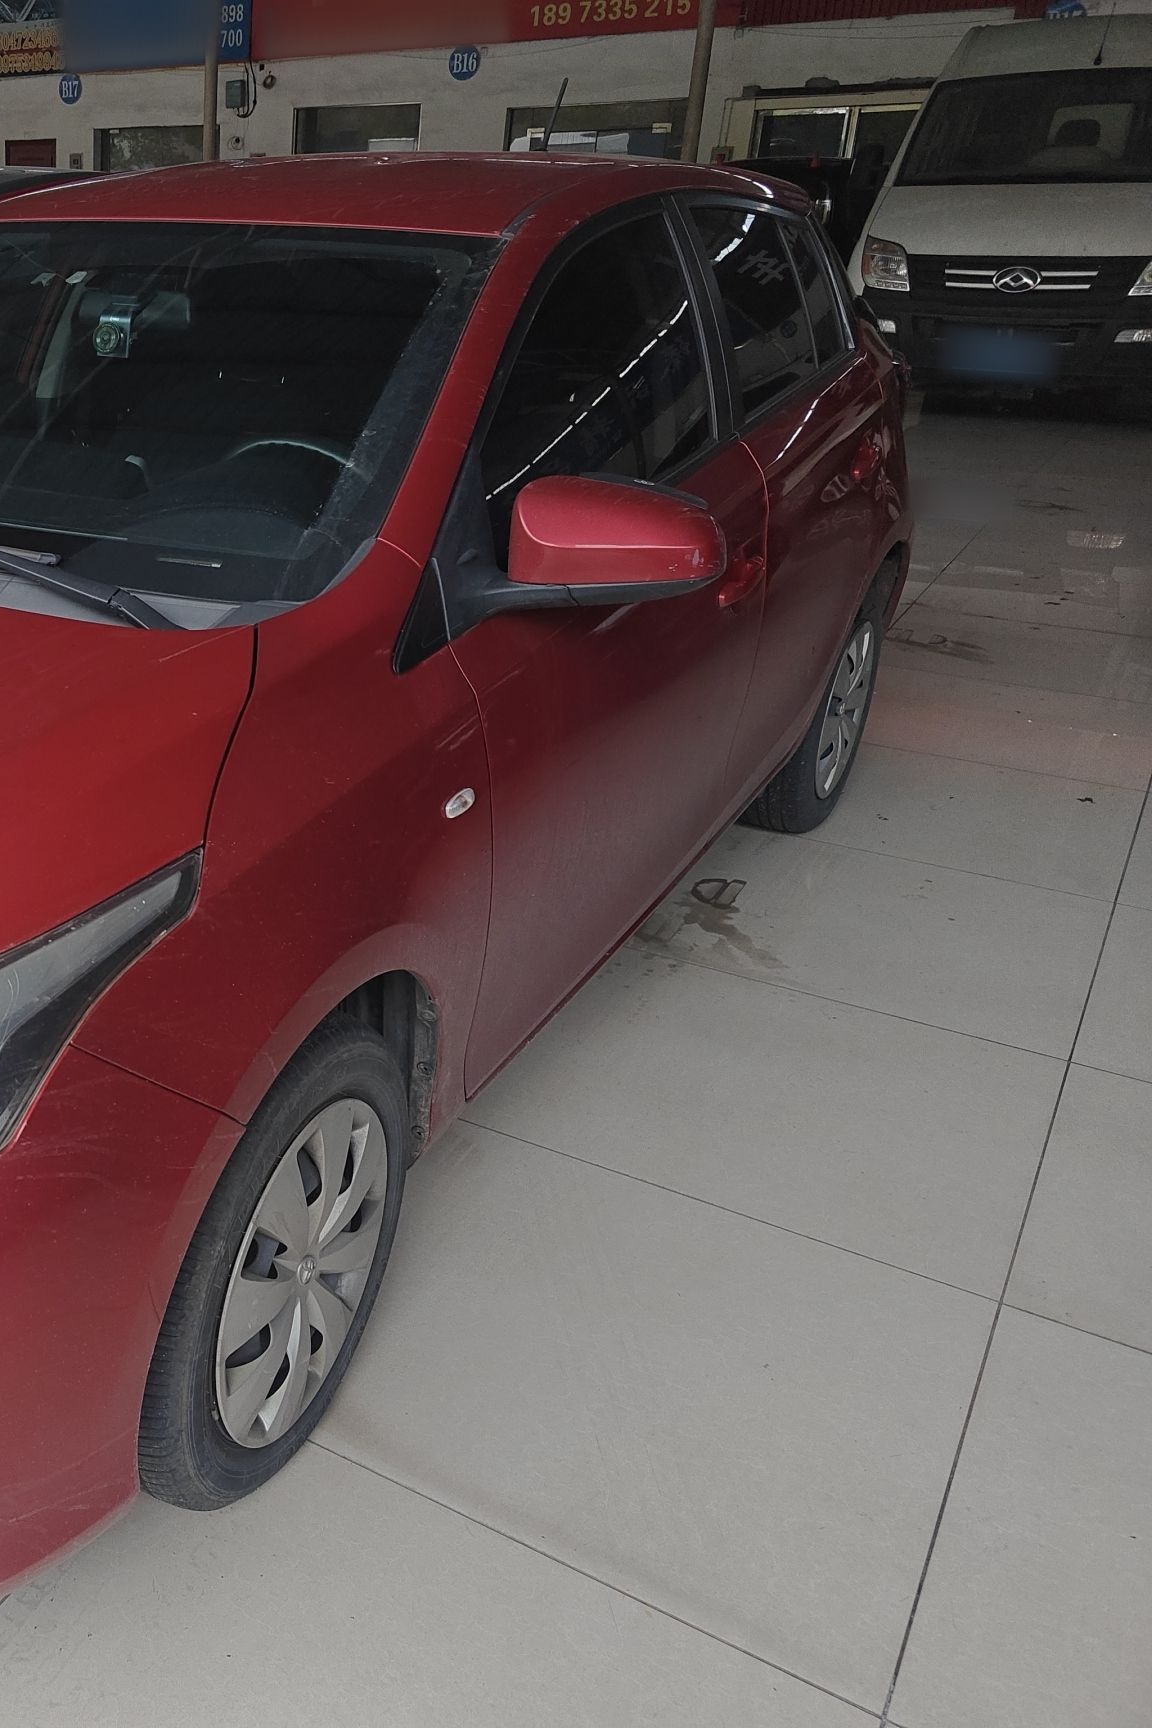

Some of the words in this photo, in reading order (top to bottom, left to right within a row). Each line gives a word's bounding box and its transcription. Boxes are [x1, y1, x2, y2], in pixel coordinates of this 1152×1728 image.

[221, 3, 244, 23] 898
[530, 4, 571, 27] 189
[580, 0, 637, 23] 7335
[220, 28, 243, 48] 700
[453, 52, 478, 73] B16
[61, 80, 79, 98] B17
